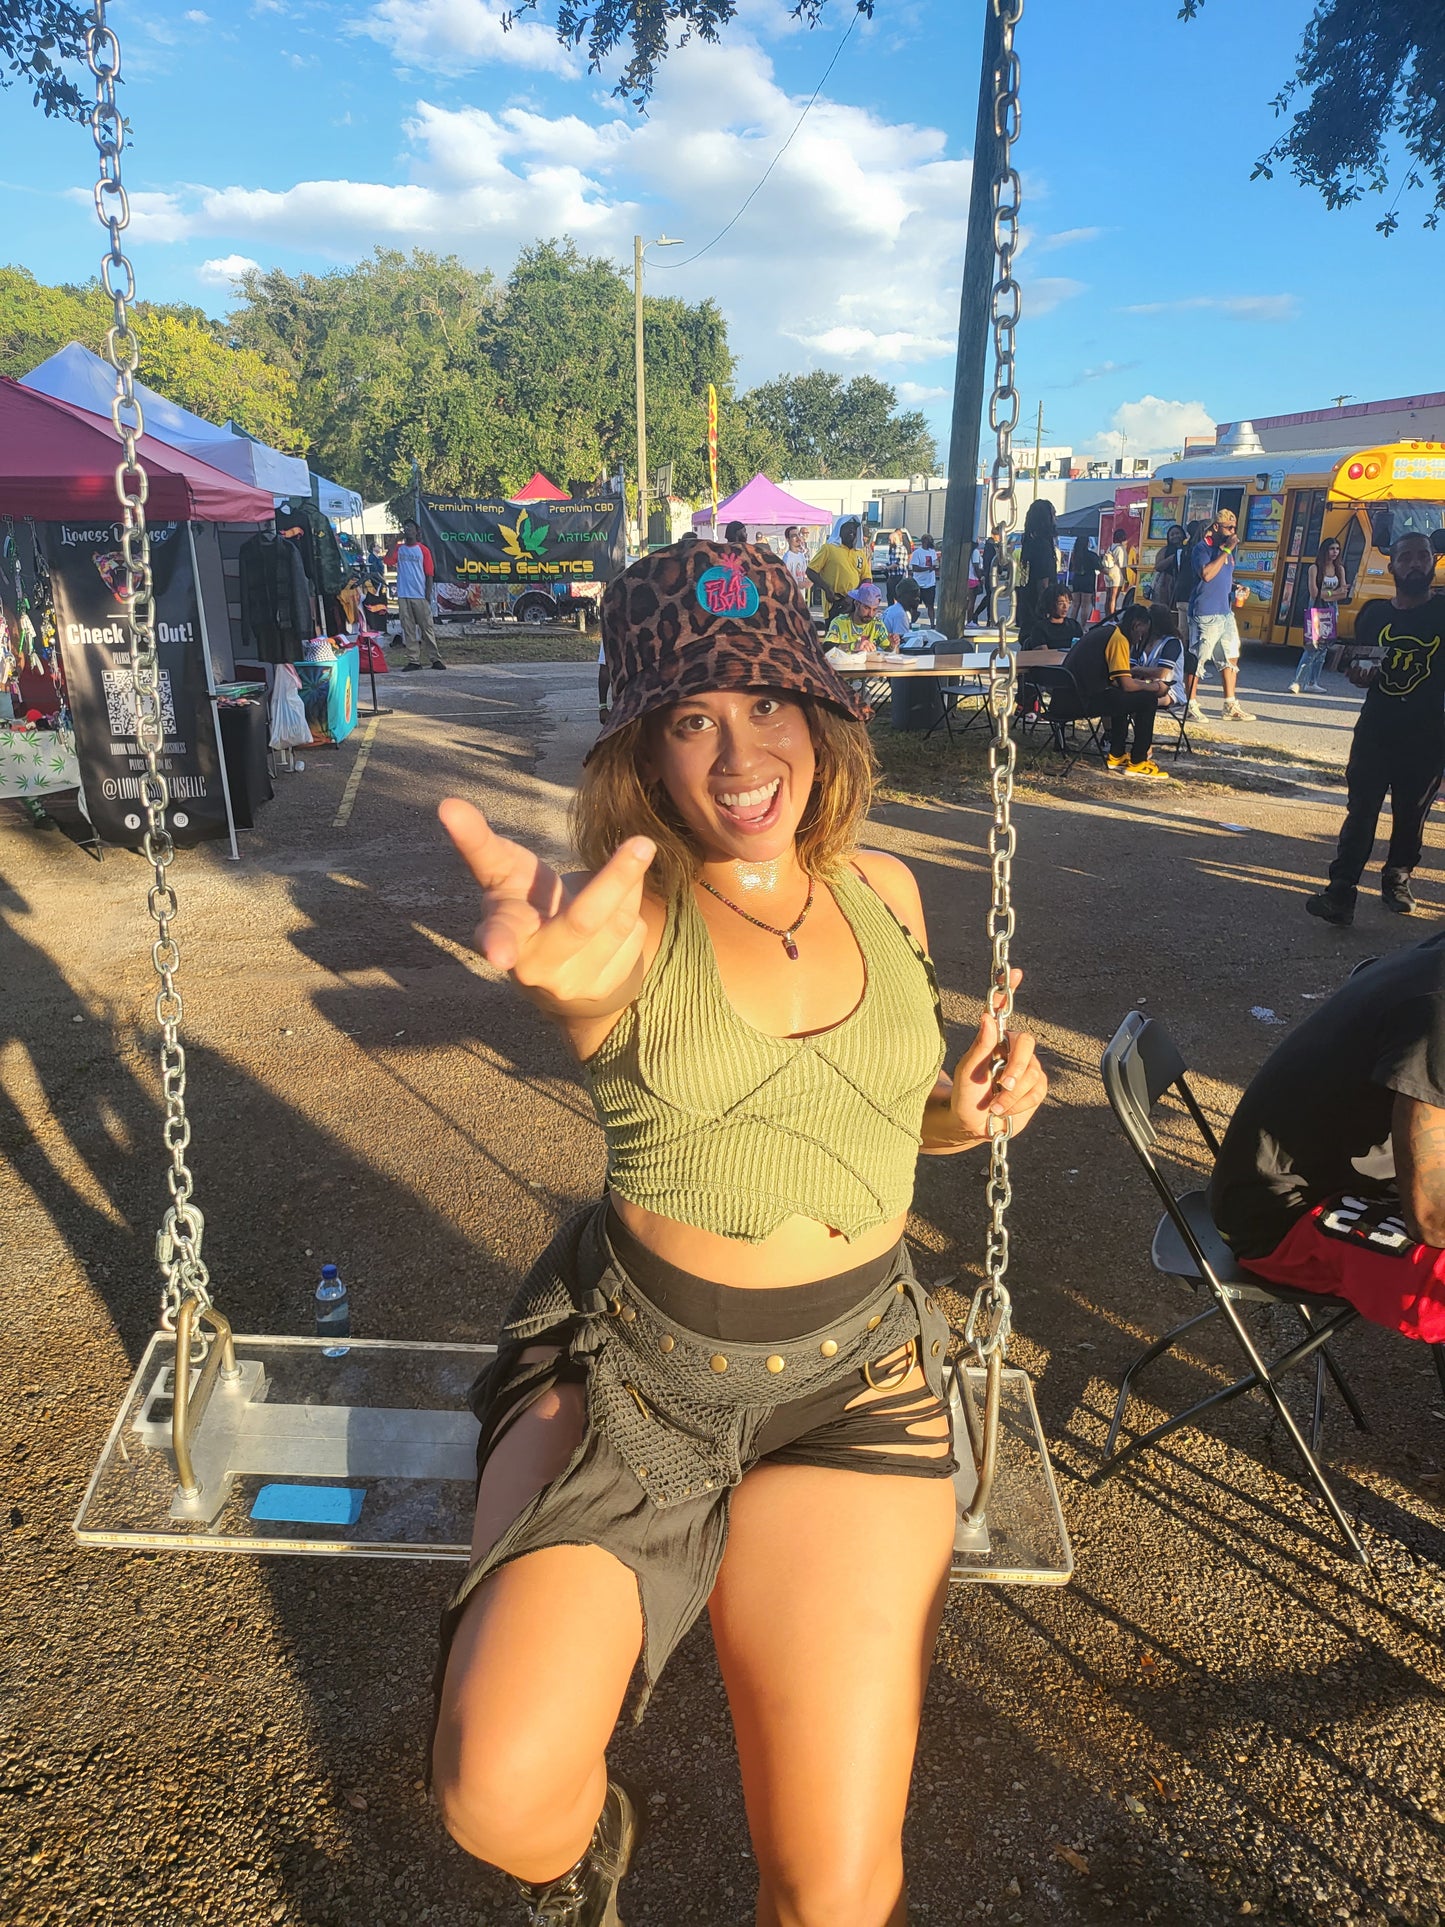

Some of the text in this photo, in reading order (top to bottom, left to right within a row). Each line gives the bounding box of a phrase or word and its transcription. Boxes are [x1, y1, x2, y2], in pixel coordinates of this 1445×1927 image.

[428, 502, 505, 515] Premium Hemp
[549, 503, 614, 513] Premium CBD
[61, 525, 109, 547] Lioness
[440, 532, 495, 543] ORGANIC
[557, 531, 608, 542] ARTISAN
[456, 557, 594, 574] JONES GENETICS
[66, 623, 126, 645] Check
[158, 622, 194, 643] Out!
